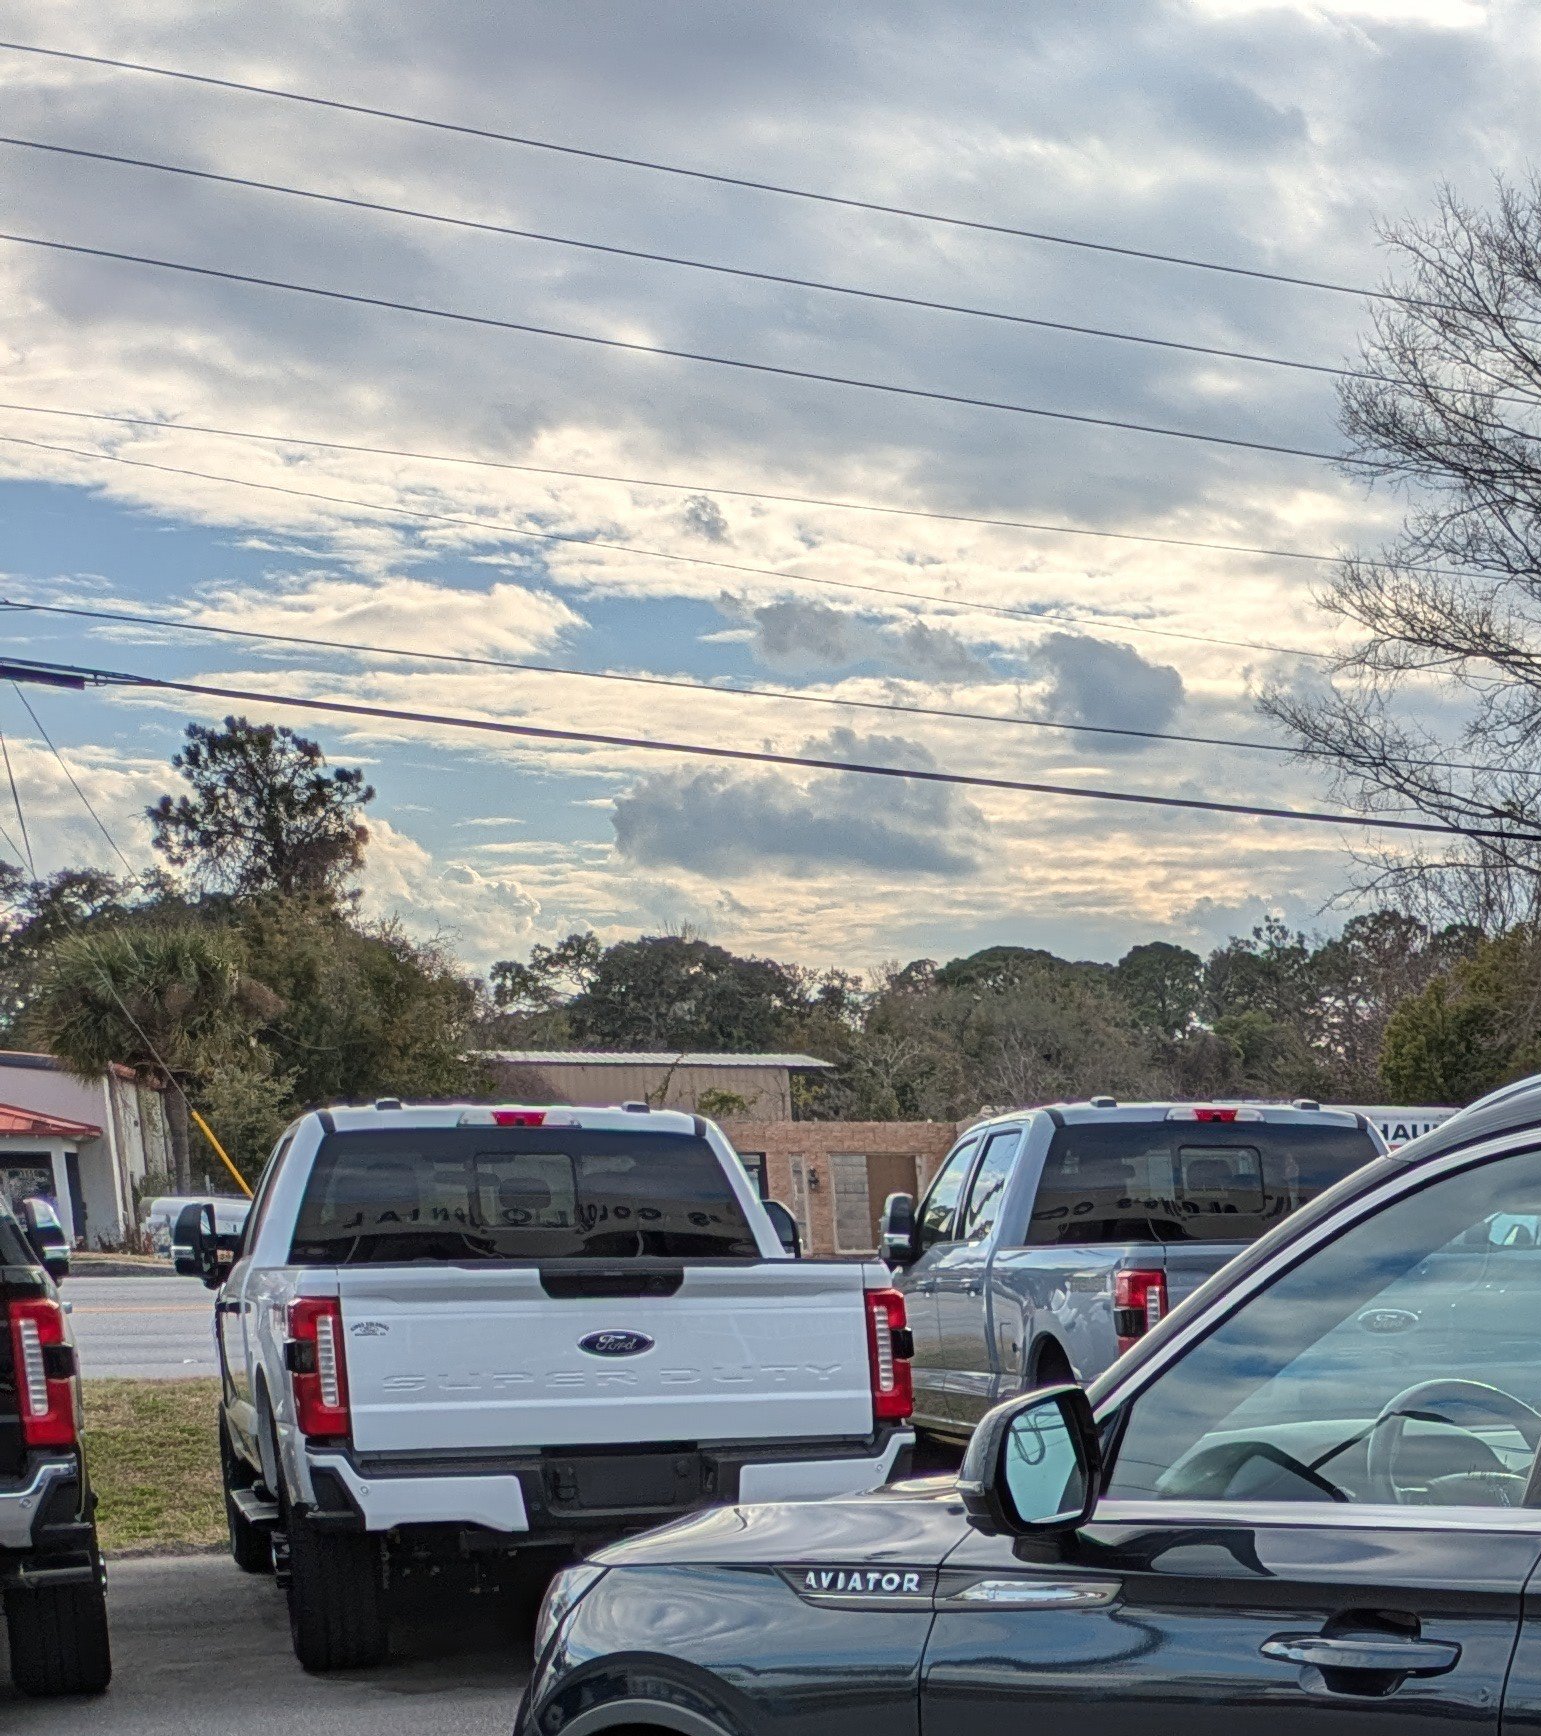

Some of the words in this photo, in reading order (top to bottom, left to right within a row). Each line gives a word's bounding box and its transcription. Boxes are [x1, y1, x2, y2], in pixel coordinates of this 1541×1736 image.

[1381, 1124, 1439, 1140] HAU
[596, 1335, 637, 1351] Ford
[383, 1368, 638, 1391] SUPER
[660, 1363, 841, 1384] DUTY
[805, 1571, 920, 1592] AVIATOR
